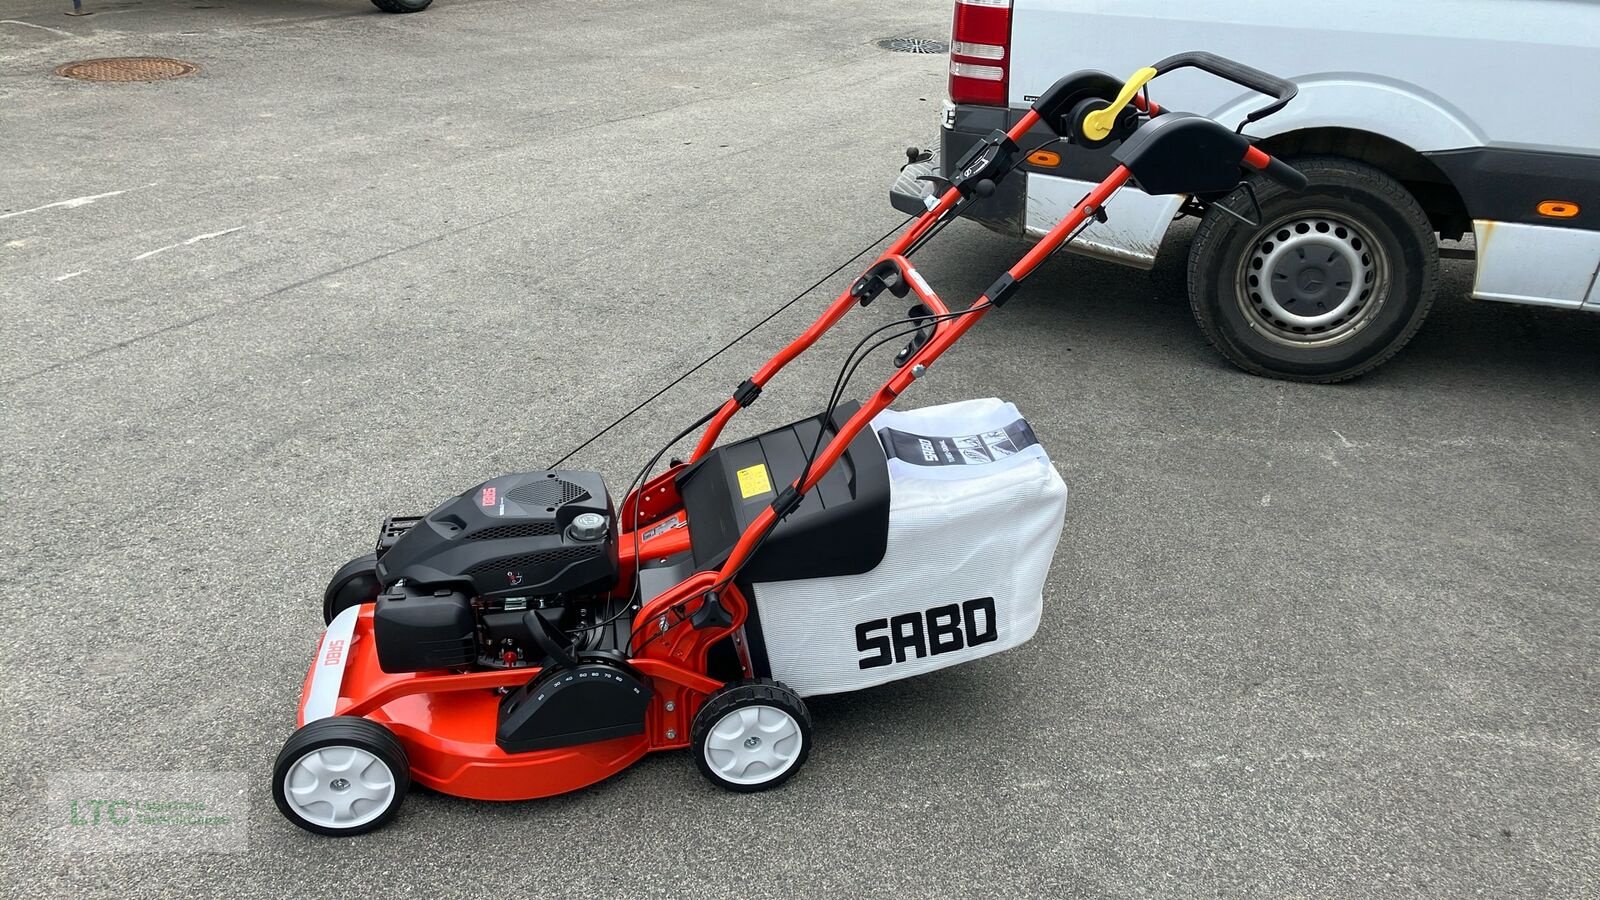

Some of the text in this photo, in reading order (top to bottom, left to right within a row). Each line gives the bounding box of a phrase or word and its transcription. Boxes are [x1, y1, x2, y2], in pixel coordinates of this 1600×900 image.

[918, 438, 938, 461] SABO
[855, 596, 998, 670] SABO
[324, 639, 345, 666] SABO
